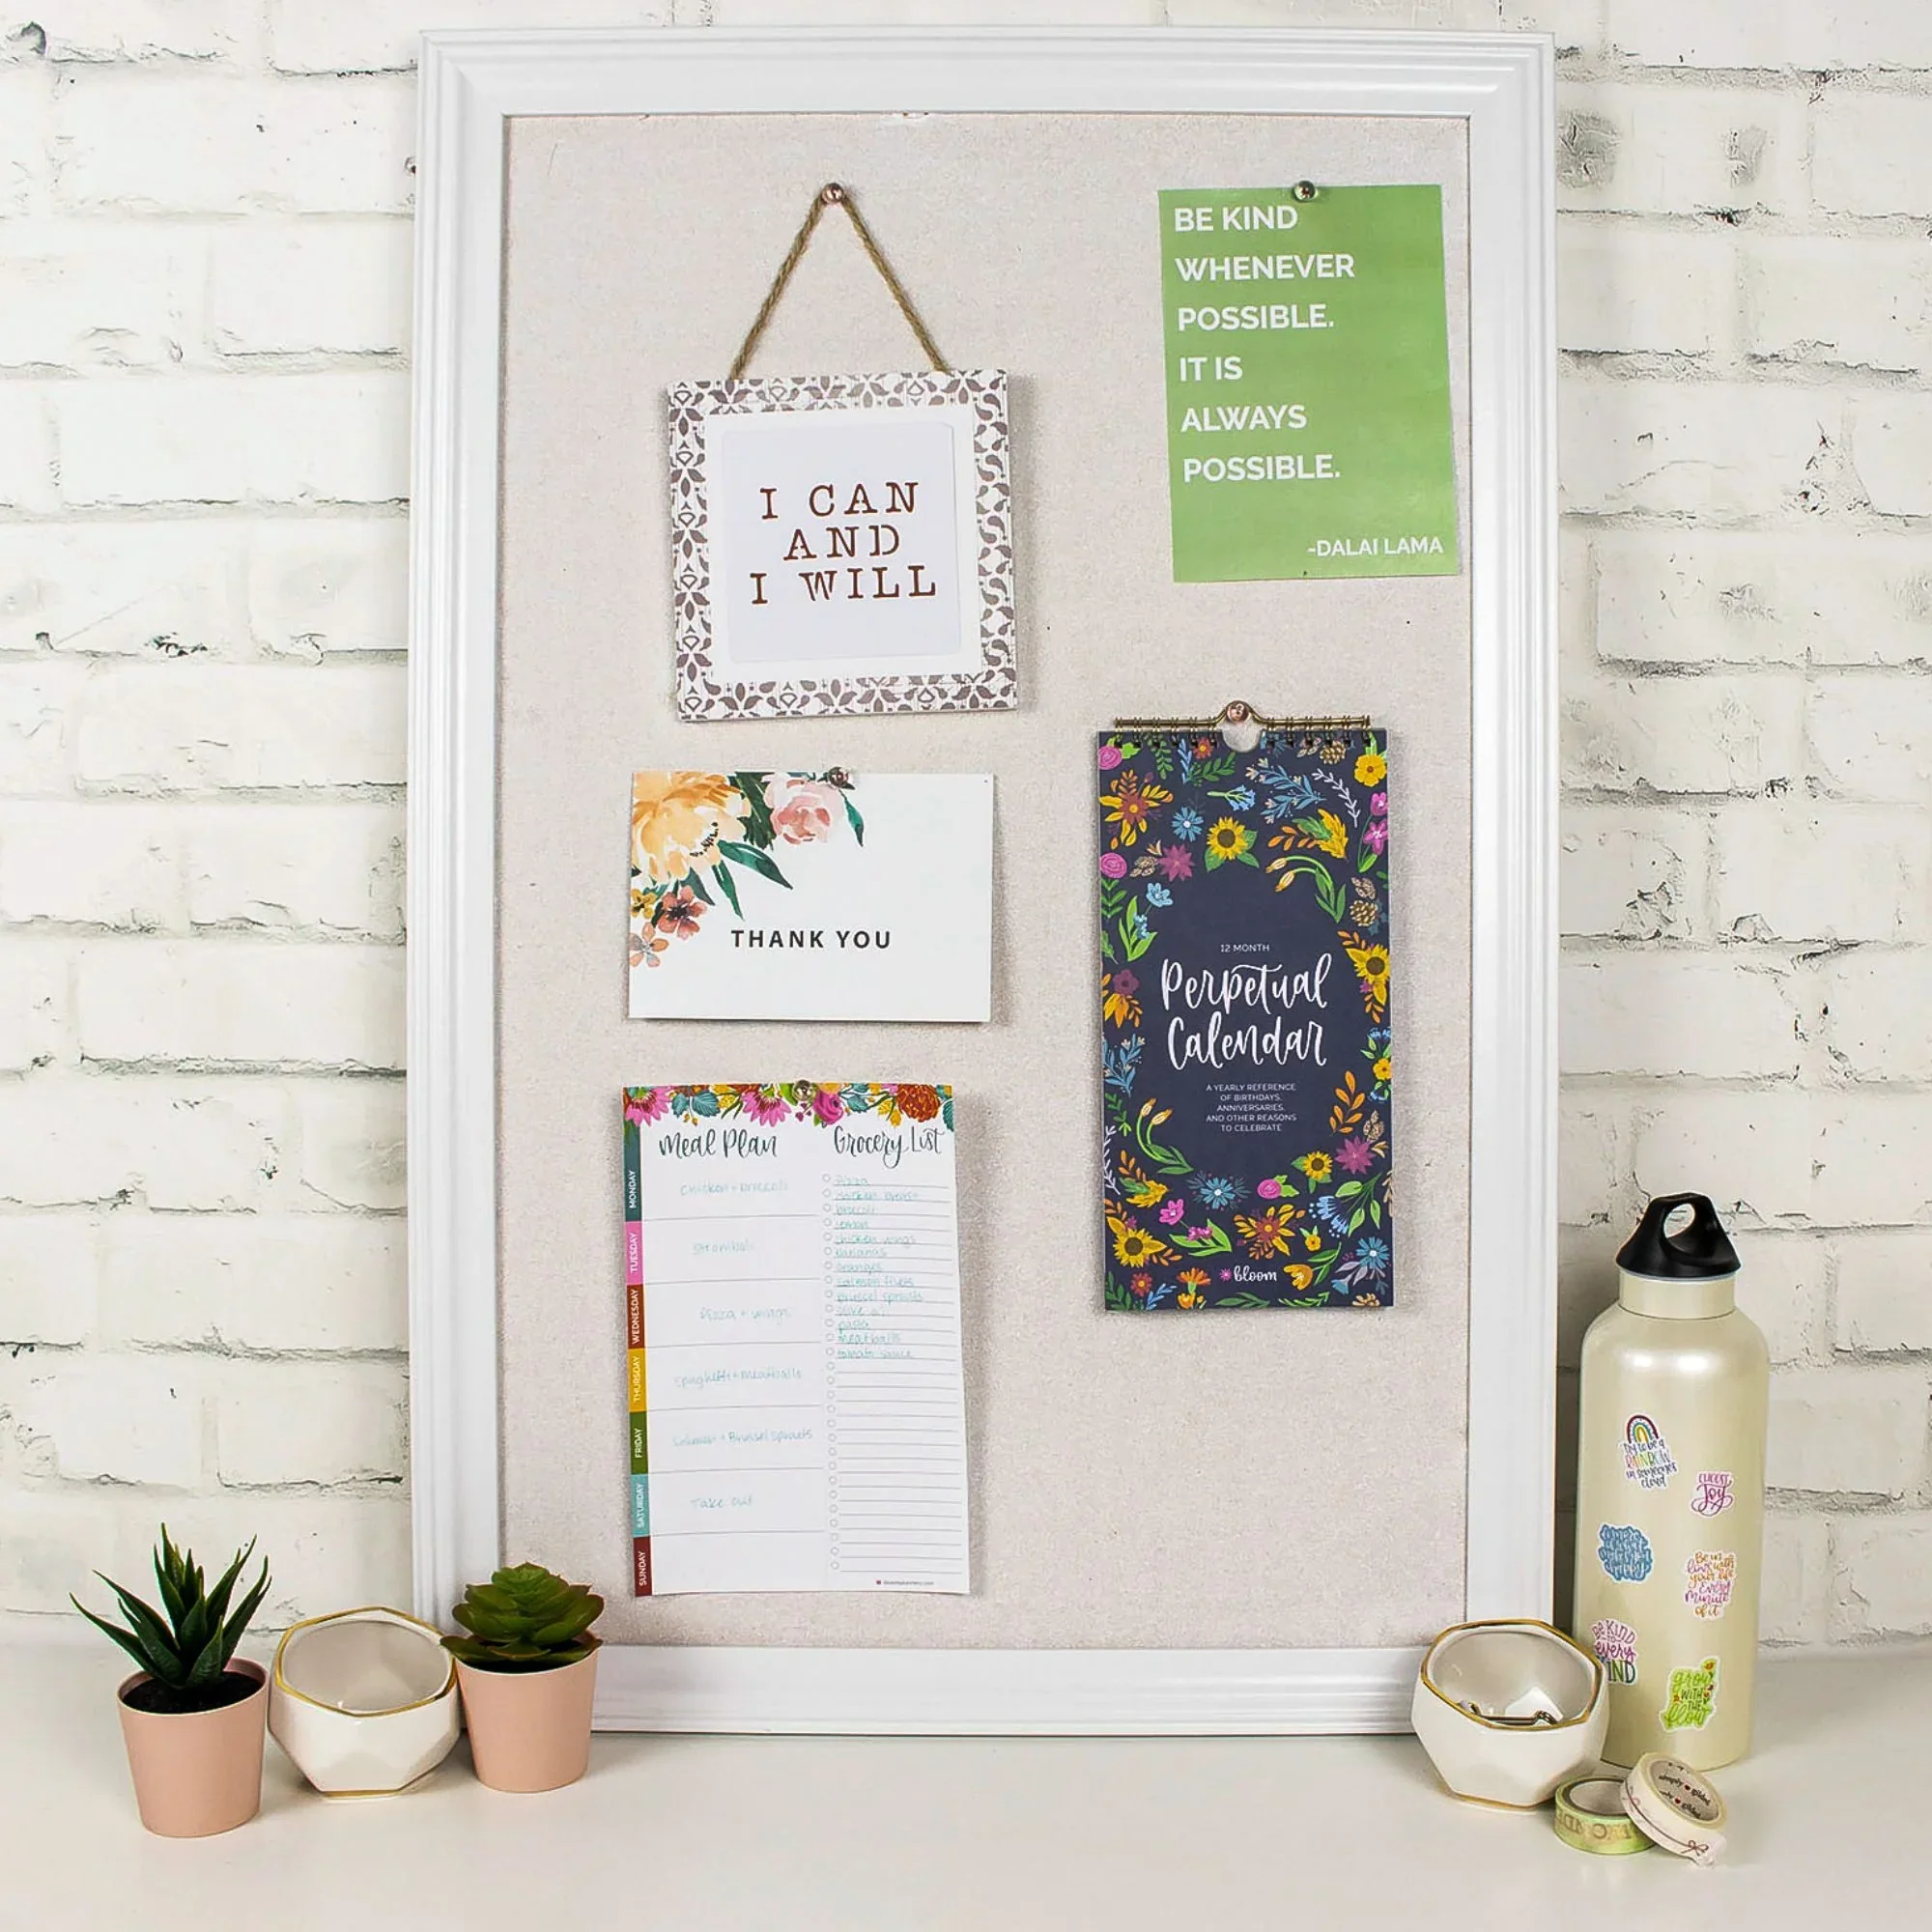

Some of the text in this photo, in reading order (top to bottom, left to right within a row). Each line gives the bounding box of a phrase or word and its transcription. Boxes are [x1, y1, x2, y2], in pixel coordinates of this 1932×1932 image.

[1175, 205, 1298, 232] BE KIND
[1175, 254, 1355, 281] WHENEVER
[1178, 303, 1334, 331] POSSIBLE.
[1179, 356, 1242, 382] IT IS
[1180, 405, 1307, 432] ALWAYS
[1183, 454, 1341, 482] POSSIBLE.
[760, 482, 919, 520] I CAN
[783, 525, 899, 560] AND
[1307, 536, 1443, 557] -DALAI LAMA
[750, 565, 936, 605] I WILL
[731, 929, 892, 950] THANK YOU
[1220, 943, 1270, 952] 12 MONTH
[1161, 952, 1332, 1014] Perpetual
[1168, 1011, 1327, 1070] Calendar
[1213, 1083, 1245, 1092] YEARLY
[1247, 1083, 1296, 1092] REFERENCE
[1234, 1123, 1282, 1132] CELEBRATE
[1257, 1113, 1297, 1122] REASONS
[724, 1129, 778, 1158] Plan
[834, 1125, 945, 1169] Grocery List
[628, 1170, 637, 1208] MONDAY
[1234, 1265, 1277, 1282] bloom
[636, 1483, 644, 1528] SATURDAY
[639, 1550, 647, 1586] SUNDAY
